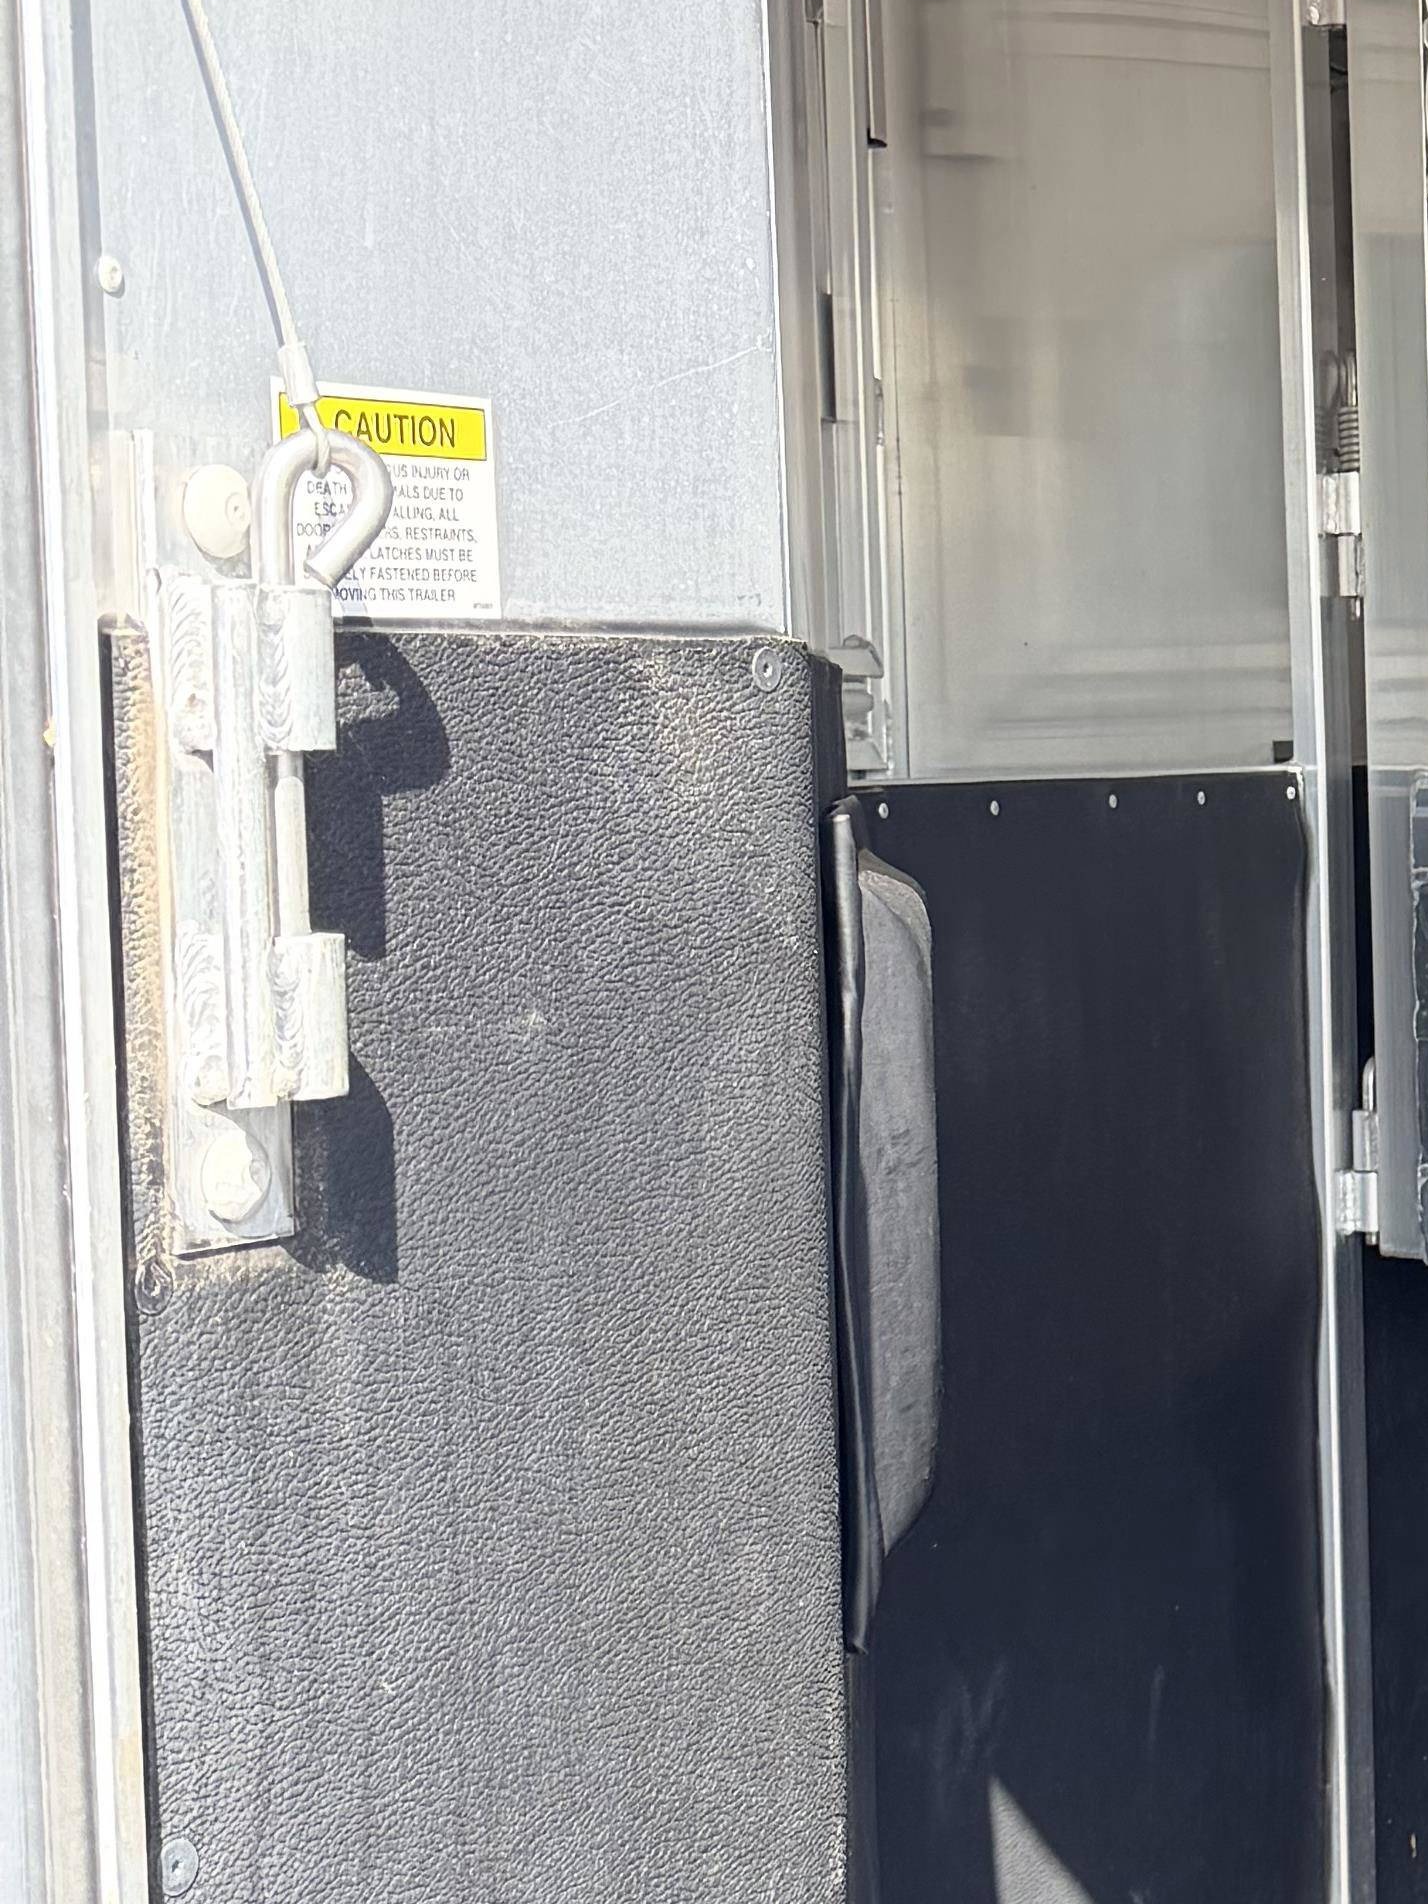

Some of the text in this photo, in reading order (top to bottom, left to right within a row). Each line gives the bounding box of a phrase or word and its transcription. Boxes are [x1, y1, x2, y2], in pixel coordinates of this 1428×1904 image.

[334, 408, 455, 448] CAUTION
[411, 464, 450, 481] INJURY
[453, 466, 470, 481] OR
[306, 480, 348, 496] DEATH
[423, 486, 446, 501] DUE
[449, 487, 464, 502] TO
[393, 506, 436, 521] ALLING,
[439, 507, 460, 522] ALL
[370, 546, 474, 563] LATCHES MUST BE
[370, 567, 430, 582] FASTENED
[433, 568, 478, 583] BEFORE
[380, 587, 406, 602] THIS
[408, 588, 456, 602] TRAILER
